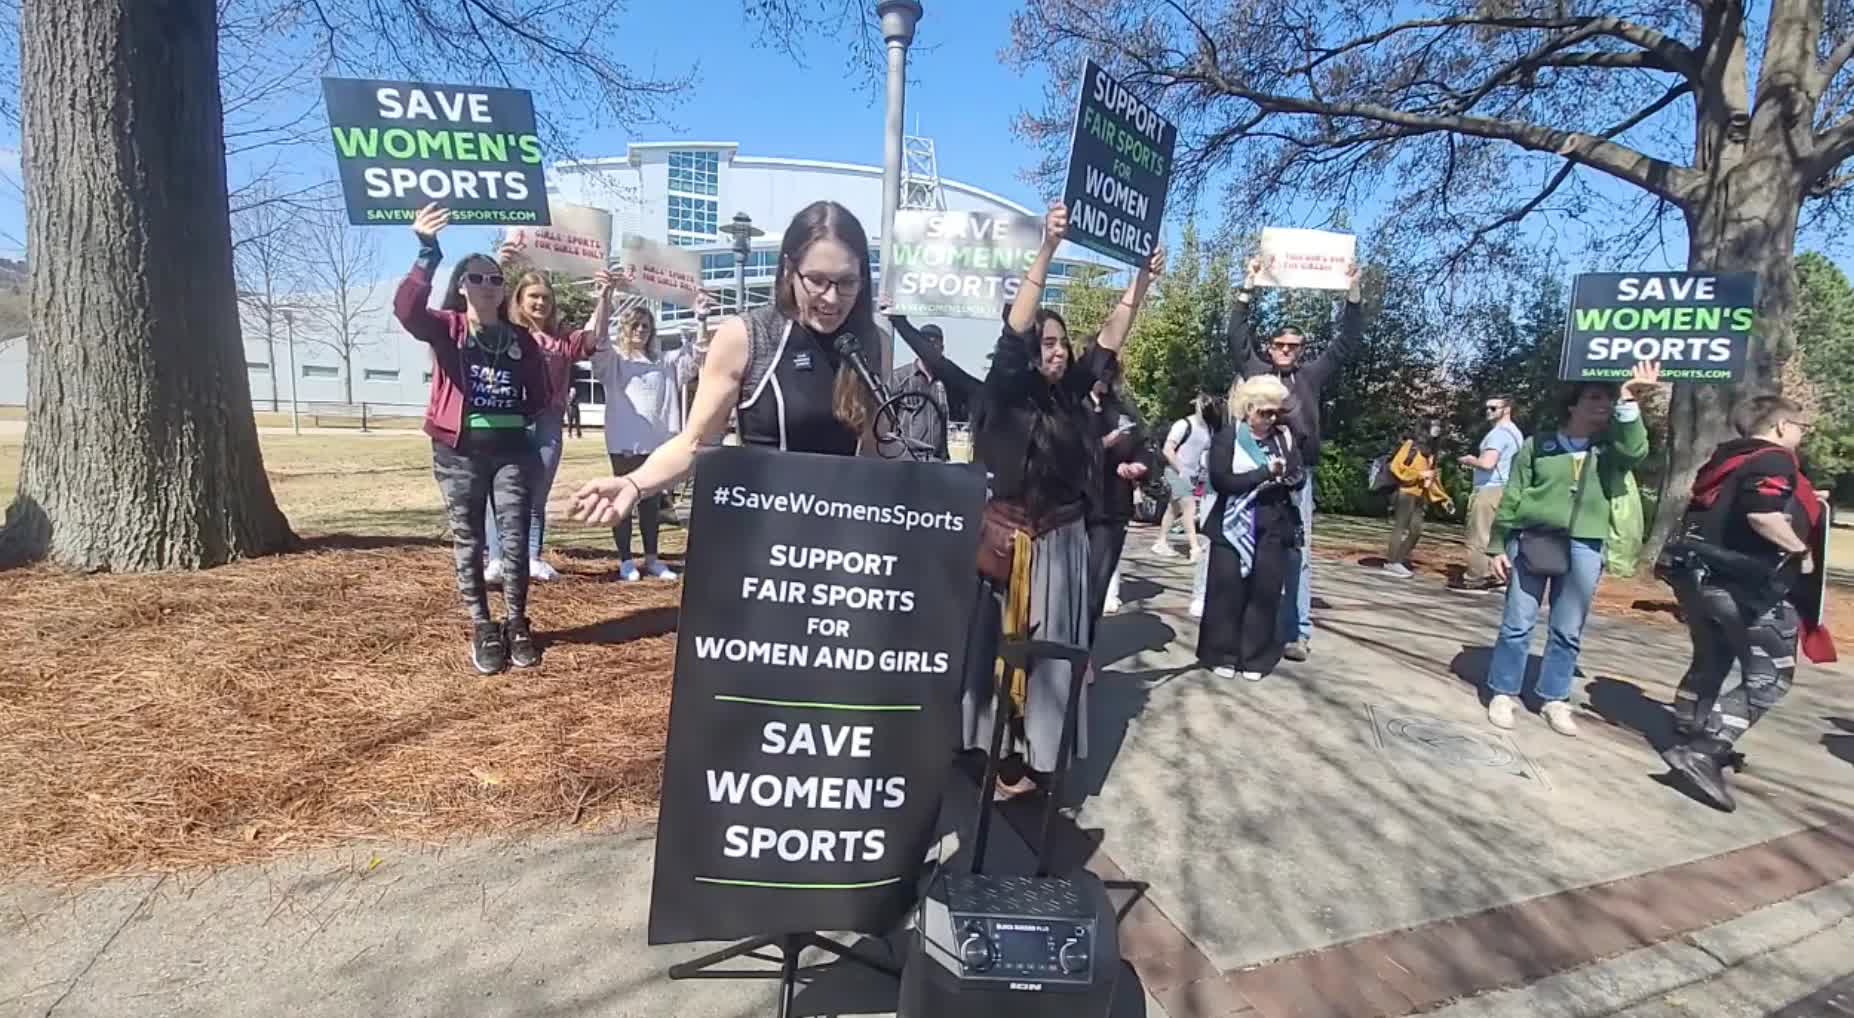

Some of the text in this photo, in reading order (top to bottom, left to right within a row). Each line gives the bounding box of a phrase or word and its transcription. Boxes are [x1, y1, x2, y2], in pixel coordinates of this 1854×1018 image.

[376, 88, 493, 123] SAVE
[1094, 70, 1167, 145] SUPPORT
[332, 127, 543, 164] WOMEN'S
[1082, 106, 1164, 177] FAIR SPORTS
[364, 168, 529, 200] SPORTS
[1113, 159, 1132, 181] FOR
[1086, 165, 1149, 221] WOMEN
[367, 209, 537, 221] SAVEWOSSPORTS.COM
[927, 216, 1009, 240] SAVE
[1070, 199, 1107, 235] AND
[1110, 218, 1152, 257] GIRLS
[893, 243, 1038, 271] WOMEN'S
[900, 272, 1021, 299] SPORTS
[1617, 277, 1716, 301] SAVE
[1575, 307, 1753, 331] WOMEN'S
[1586, 337, 1732, 361] SPORTS
[470, 364, 511, 384] SAVE
[713, 486, 964, 532] #SaveWomensSports
[769, 544, 898, 577] SUPPORT
[742, 577, 915, 612] FAIR SPORTS
[807, 617, 850, 638] FOR
[695, 637, 949, 674] WOMEN AND GIRLS
[761, 721, 874, 758] SAVE
[705, 770, 906, 810] WOMEN'S
[723, 825, 886, 862] SPORTS
